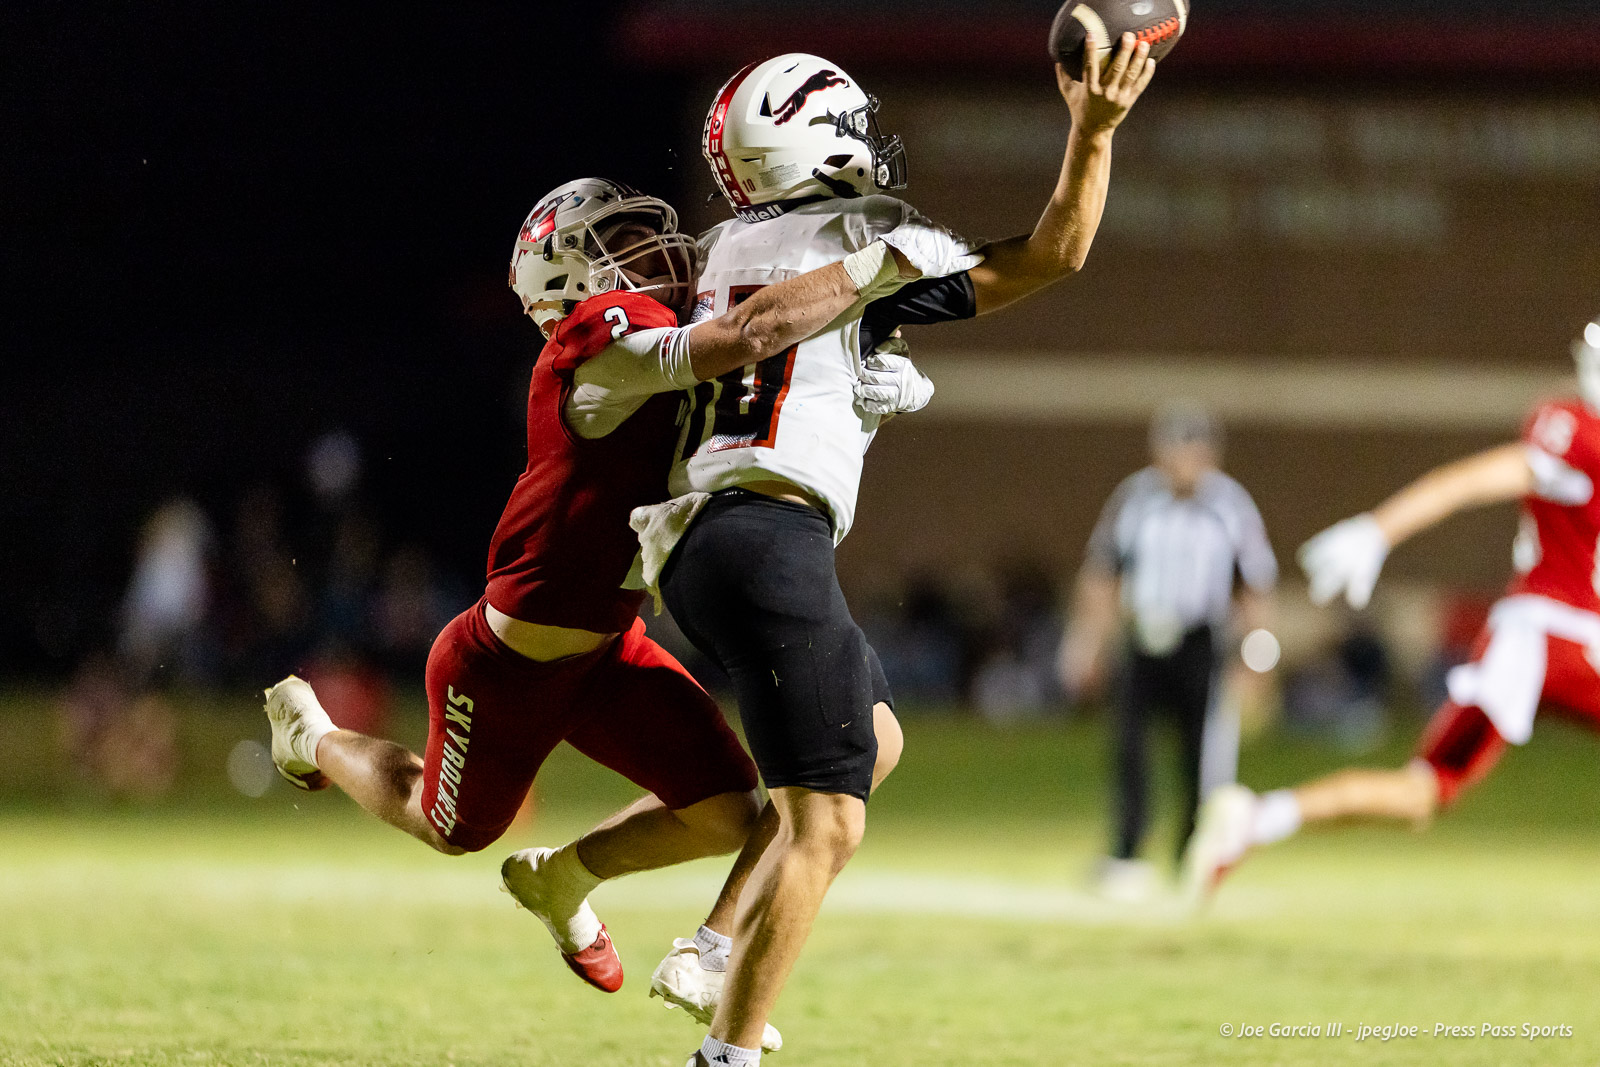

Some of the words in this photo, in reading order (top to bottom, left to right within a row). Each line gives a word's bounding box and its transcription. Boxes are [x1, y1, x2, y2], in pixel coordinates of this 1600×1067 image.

[741, 178, 757, 194] 10
[736, 203, 785, 224] ddell
[603, 305, 630, 340] 2
[430, 684, 474, 837] SKYROCKETS
